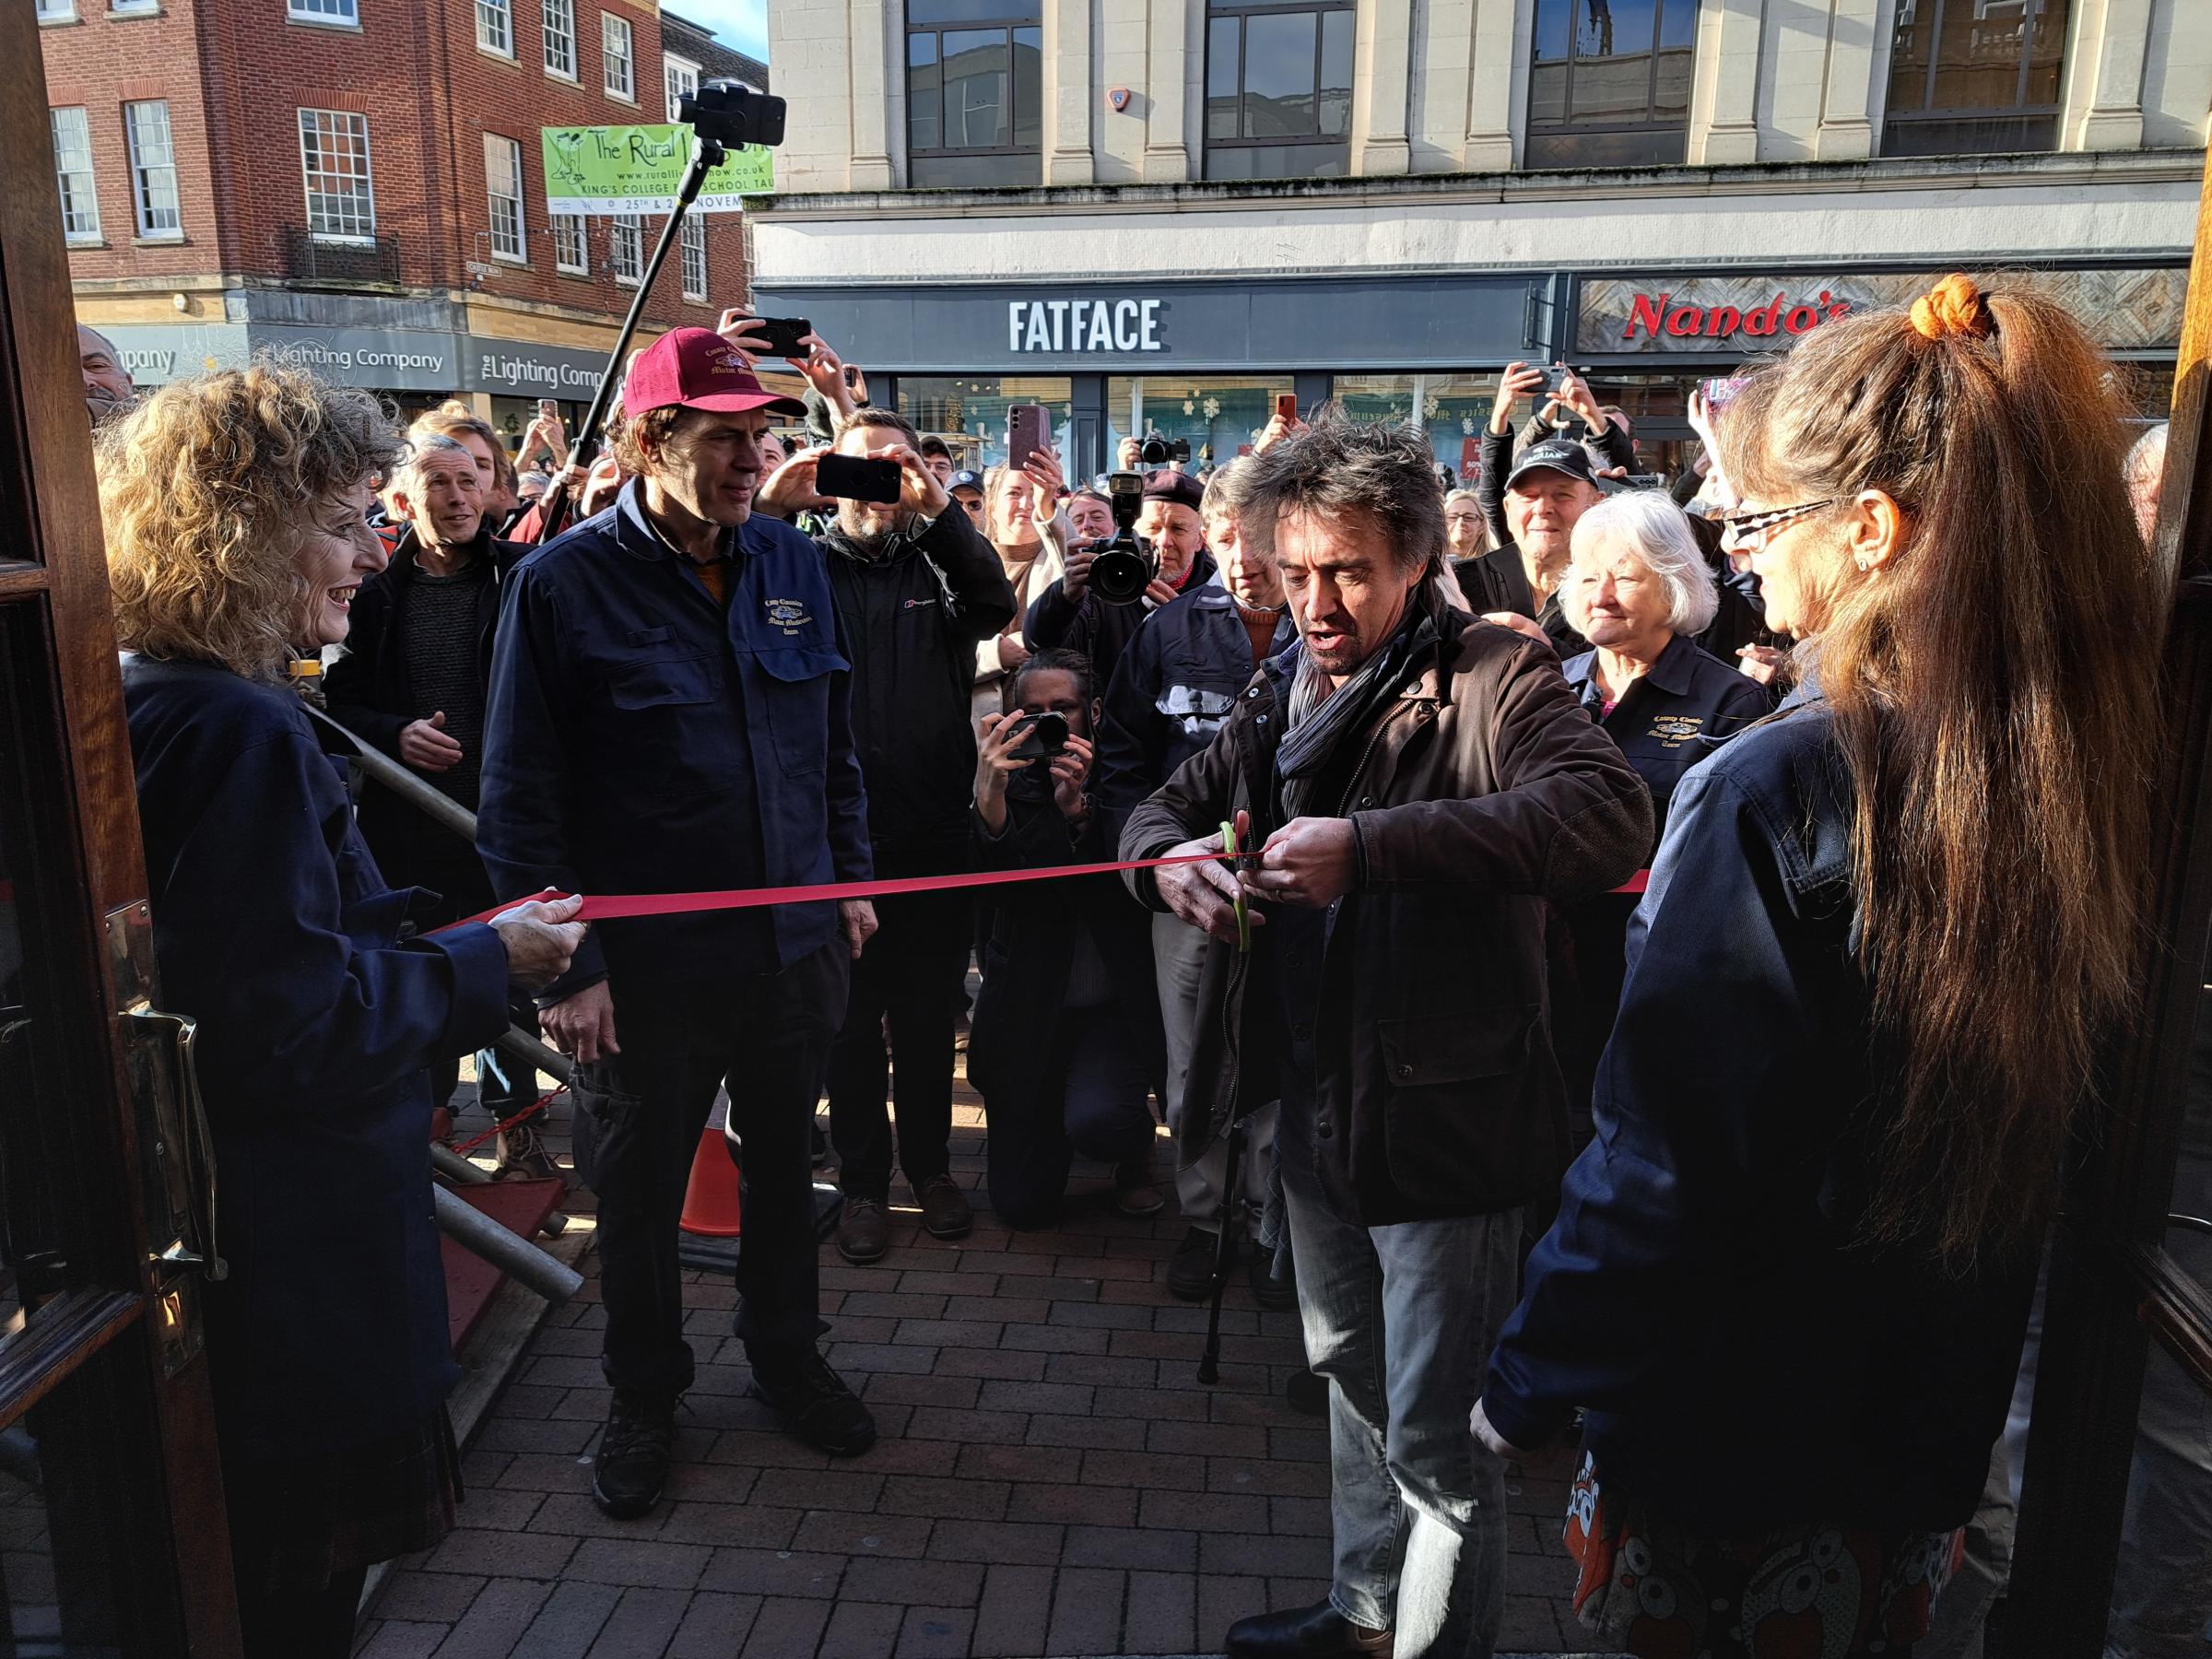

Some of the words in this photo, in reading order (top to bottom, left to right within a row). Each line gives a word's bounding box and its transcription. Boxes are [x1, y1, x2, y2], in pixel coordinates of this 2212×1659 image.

[588, 130, 621, 159] The
[629, 131, 675, 167] Rural
[582, 185, 618, 194] KING'S
[622, 184, 669, 194] COLLEGE
[697, 195, 744, 208] NOVEM
[1009, 300, 1160, 350] FATFACE
[1622, 289, 1851, 338] Nando's
[356, 348, 443, 372] Company
[482, 355, 491, 380] The
[491, 355, 558, 389] Lighting
